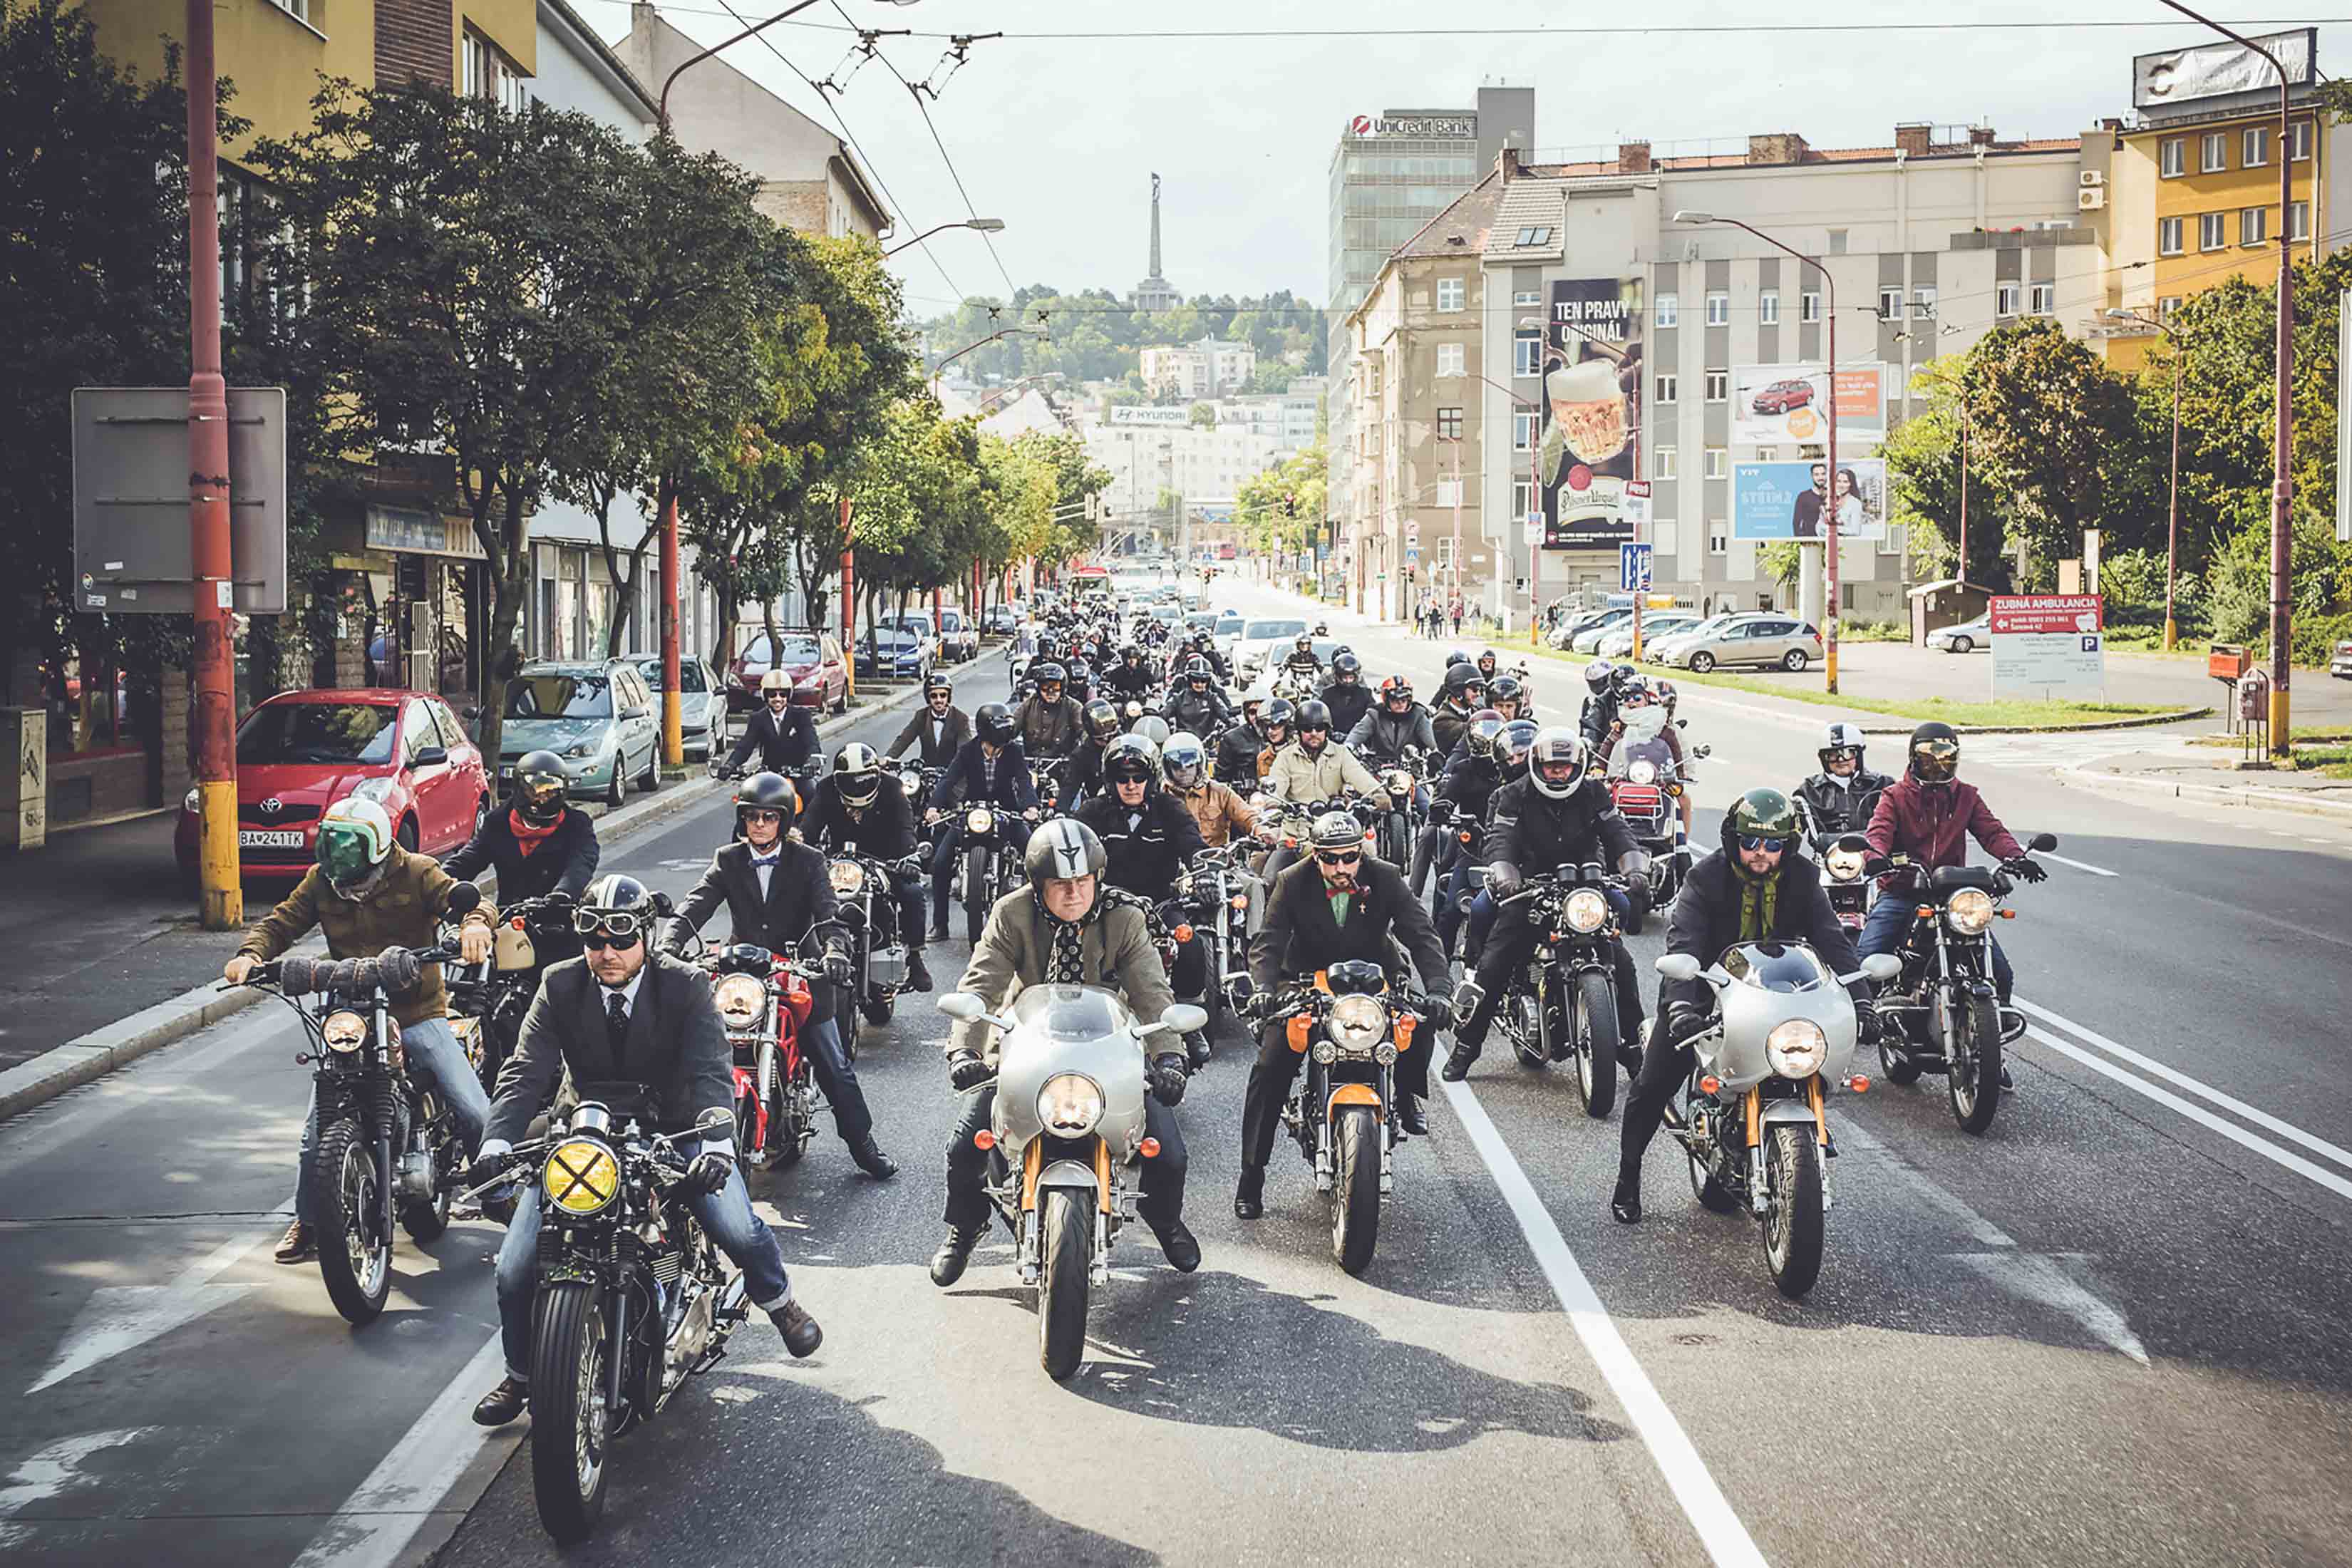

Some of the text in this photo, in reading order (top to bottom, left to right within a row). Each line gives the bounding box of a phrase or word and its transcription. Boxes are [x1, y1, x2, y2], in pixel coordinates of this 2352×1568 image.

[1374, 118, 1470, 133] UniCredit Bank
[1554, 301, 1582, 321] TEN
[1561, 319, 1625, 343] ORIGINÁL
[1137, 410, 1187, 421] HYUNDAI
[1996, 597, 2098, 610] ZUBNÁ AMBULANCIA
[2085, 638, 2095, 650] P
